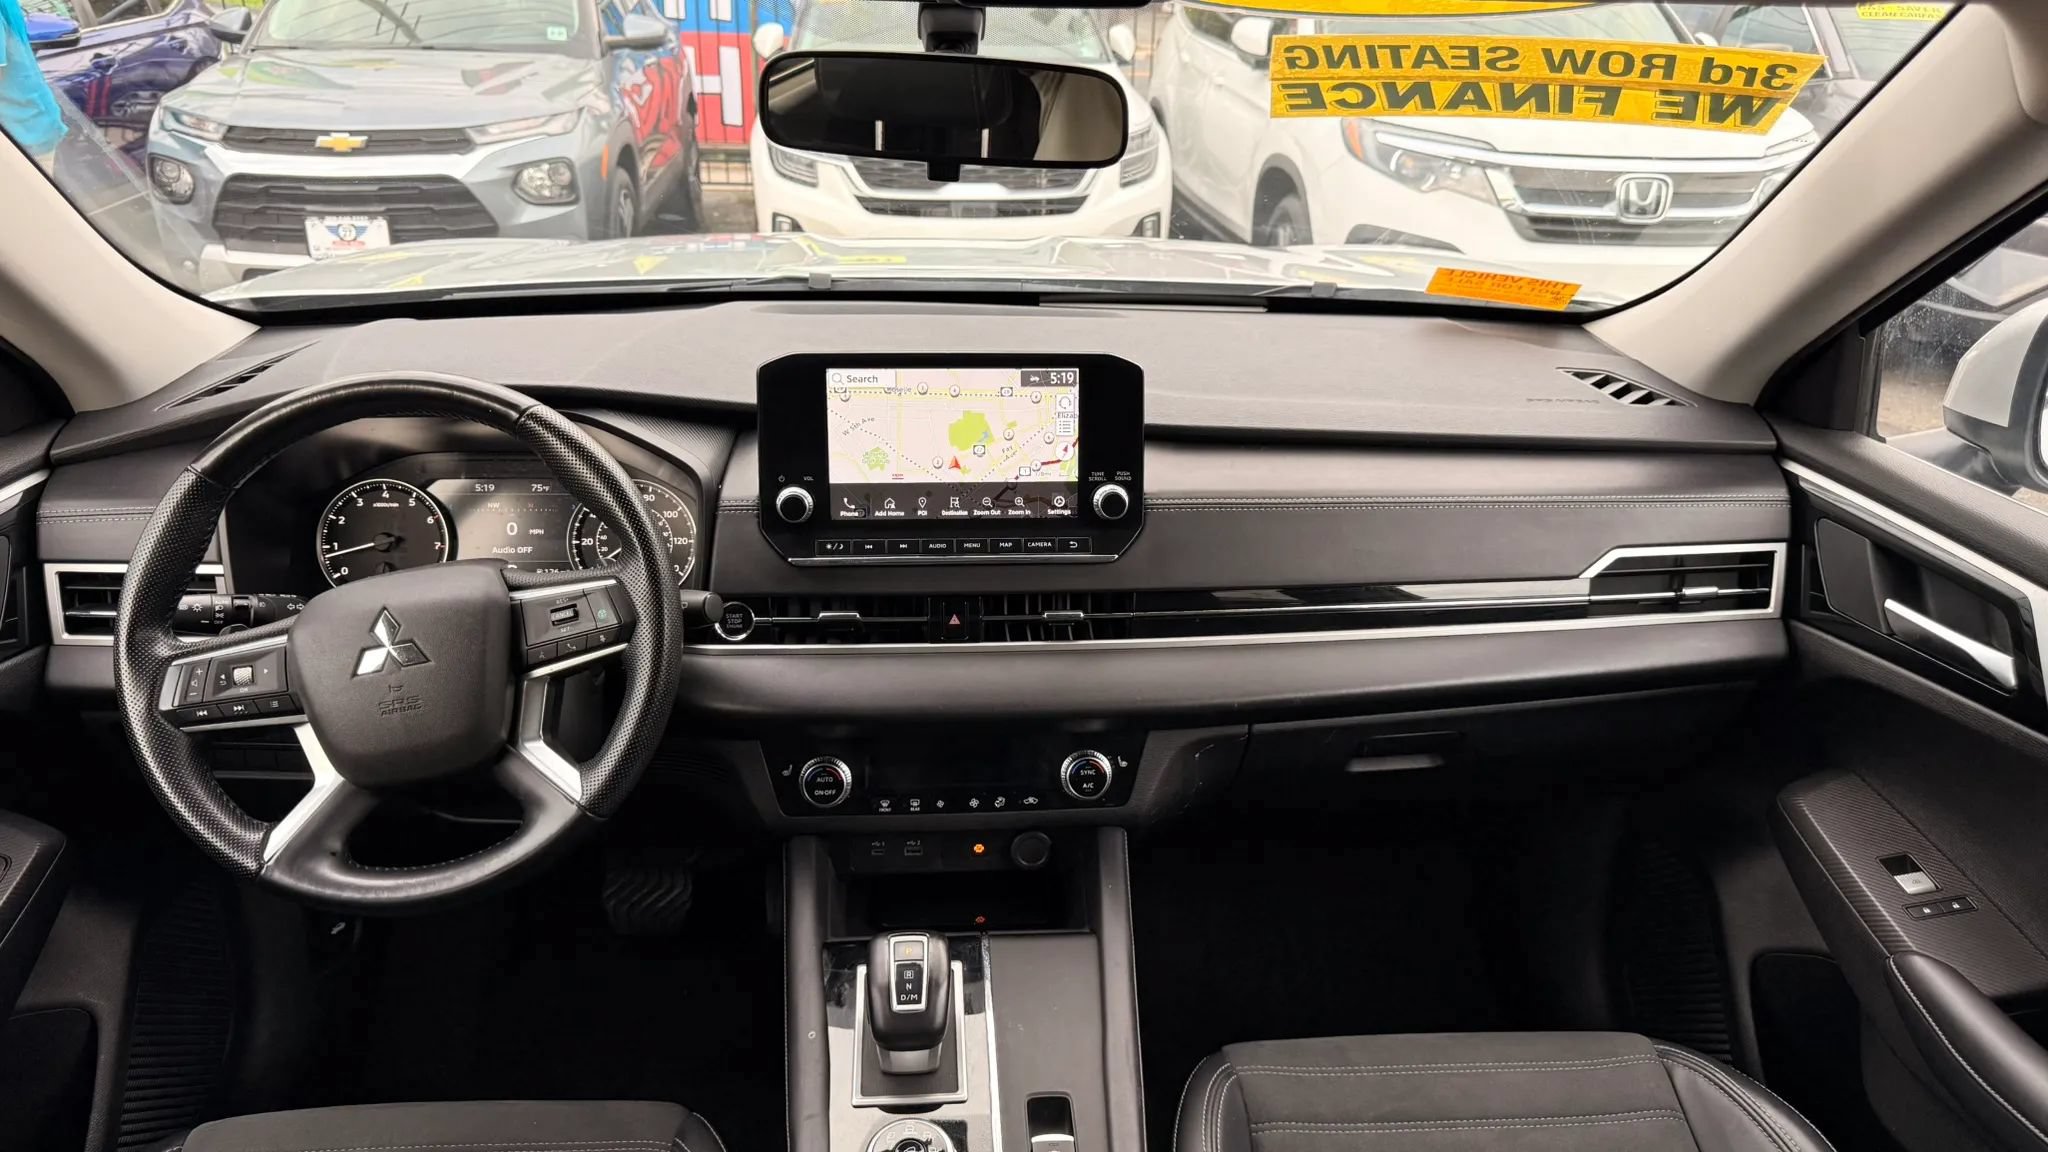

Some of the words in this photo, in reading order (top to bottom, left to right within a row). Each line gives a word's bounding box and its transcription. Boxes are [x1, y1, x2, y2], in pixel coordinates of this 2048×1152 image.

[846, 374, 879, 384] Search
[1050, 371, 1075, 385] 5:19
[475, 483, 496, 493] 5:19
[381, 490, 390, 499] 4
[356, 498, 364, 507] 3
[408, 498, 416, 507] 5
[663, 510, 679, 518] 100
[1047, 508, 1072, 517] Settings
[338, 516, 346, 525] 2
[426, 515, 435, 524] 6
[506, 521, 518, 536] 0
[581, 537, 594, 546] 20
[673, 537, 688, 545] 120
[332, 542, 338, 550] 1
[433, 542, 441, 550] 7
[491, 546, 516, 554] Audio
[517, 546, 533, 554] OFF
[340, 566, 349, 575] 0
[905, 982, 912, 991] N
[900, 993, 918, 1001] D/M
